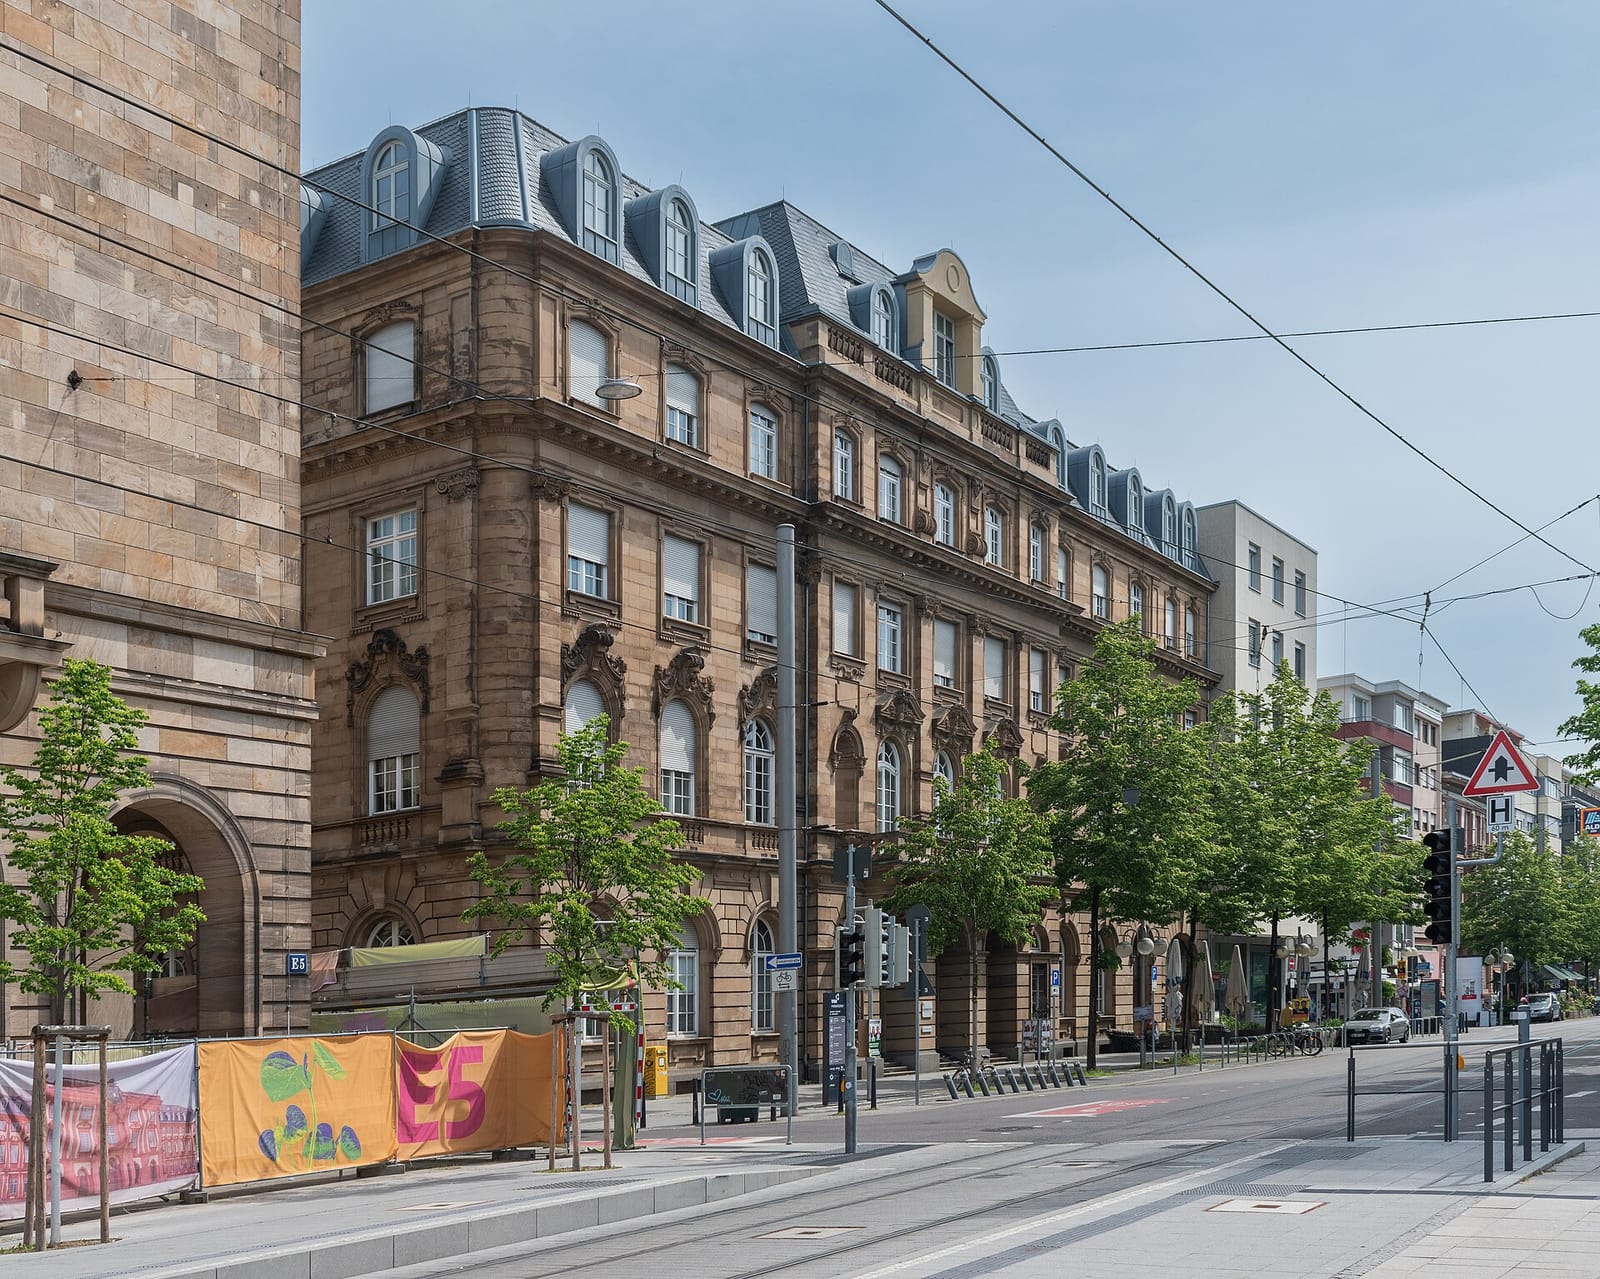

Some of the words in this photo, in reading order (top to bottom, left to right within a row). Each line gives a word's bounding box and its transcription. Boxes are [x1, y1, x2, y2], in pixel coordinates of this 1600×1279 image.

[1491, 798, 1510, 823] H
[291, 957, 305, 970] E5
[398, 1045, 486, 1143] E5
